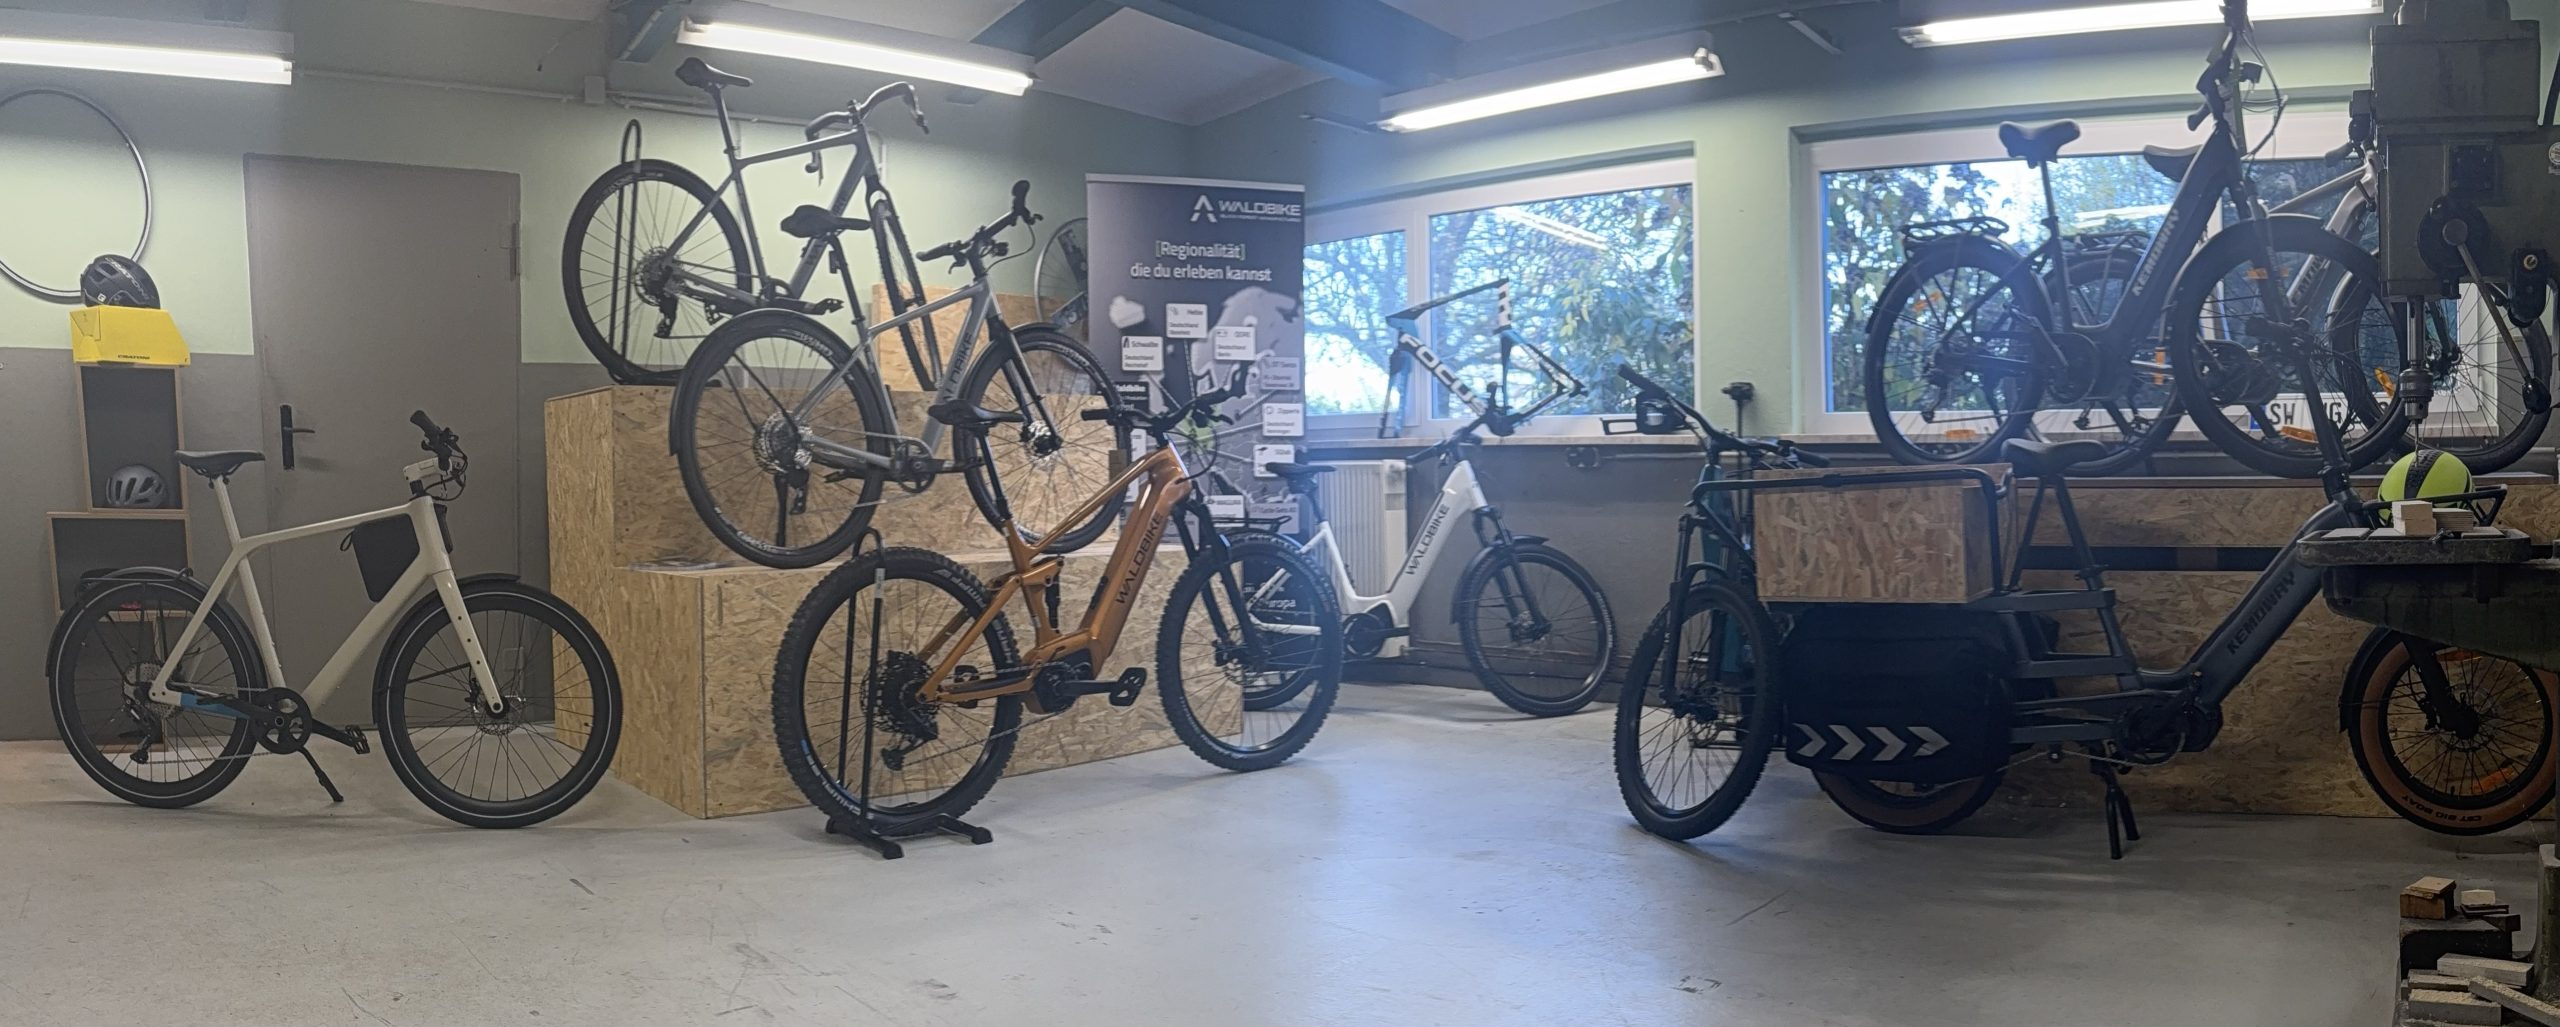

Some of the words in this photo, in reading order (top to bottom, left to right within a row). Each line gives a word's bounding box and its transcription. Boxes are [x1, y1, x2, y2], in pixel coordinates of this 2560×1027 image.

[1218, 200, 1301, 216] WALDBIKE
[1155, 240, 1246, 261] [Regionalität]
[1130, 262, 1151, 278] die
[1153, 263, 1171, 279] du
[1173, 264, 1223, 280] erleben
[1225, 265, 1272, 282] kannst
[1399, 333, 1489, 418] FOCUS
[1116, 384, 1147, 393] aldbike
[1406, 503, 1451, 575] WALDBIKE
[1115, 512, 1164, 604] WALDBIKE
